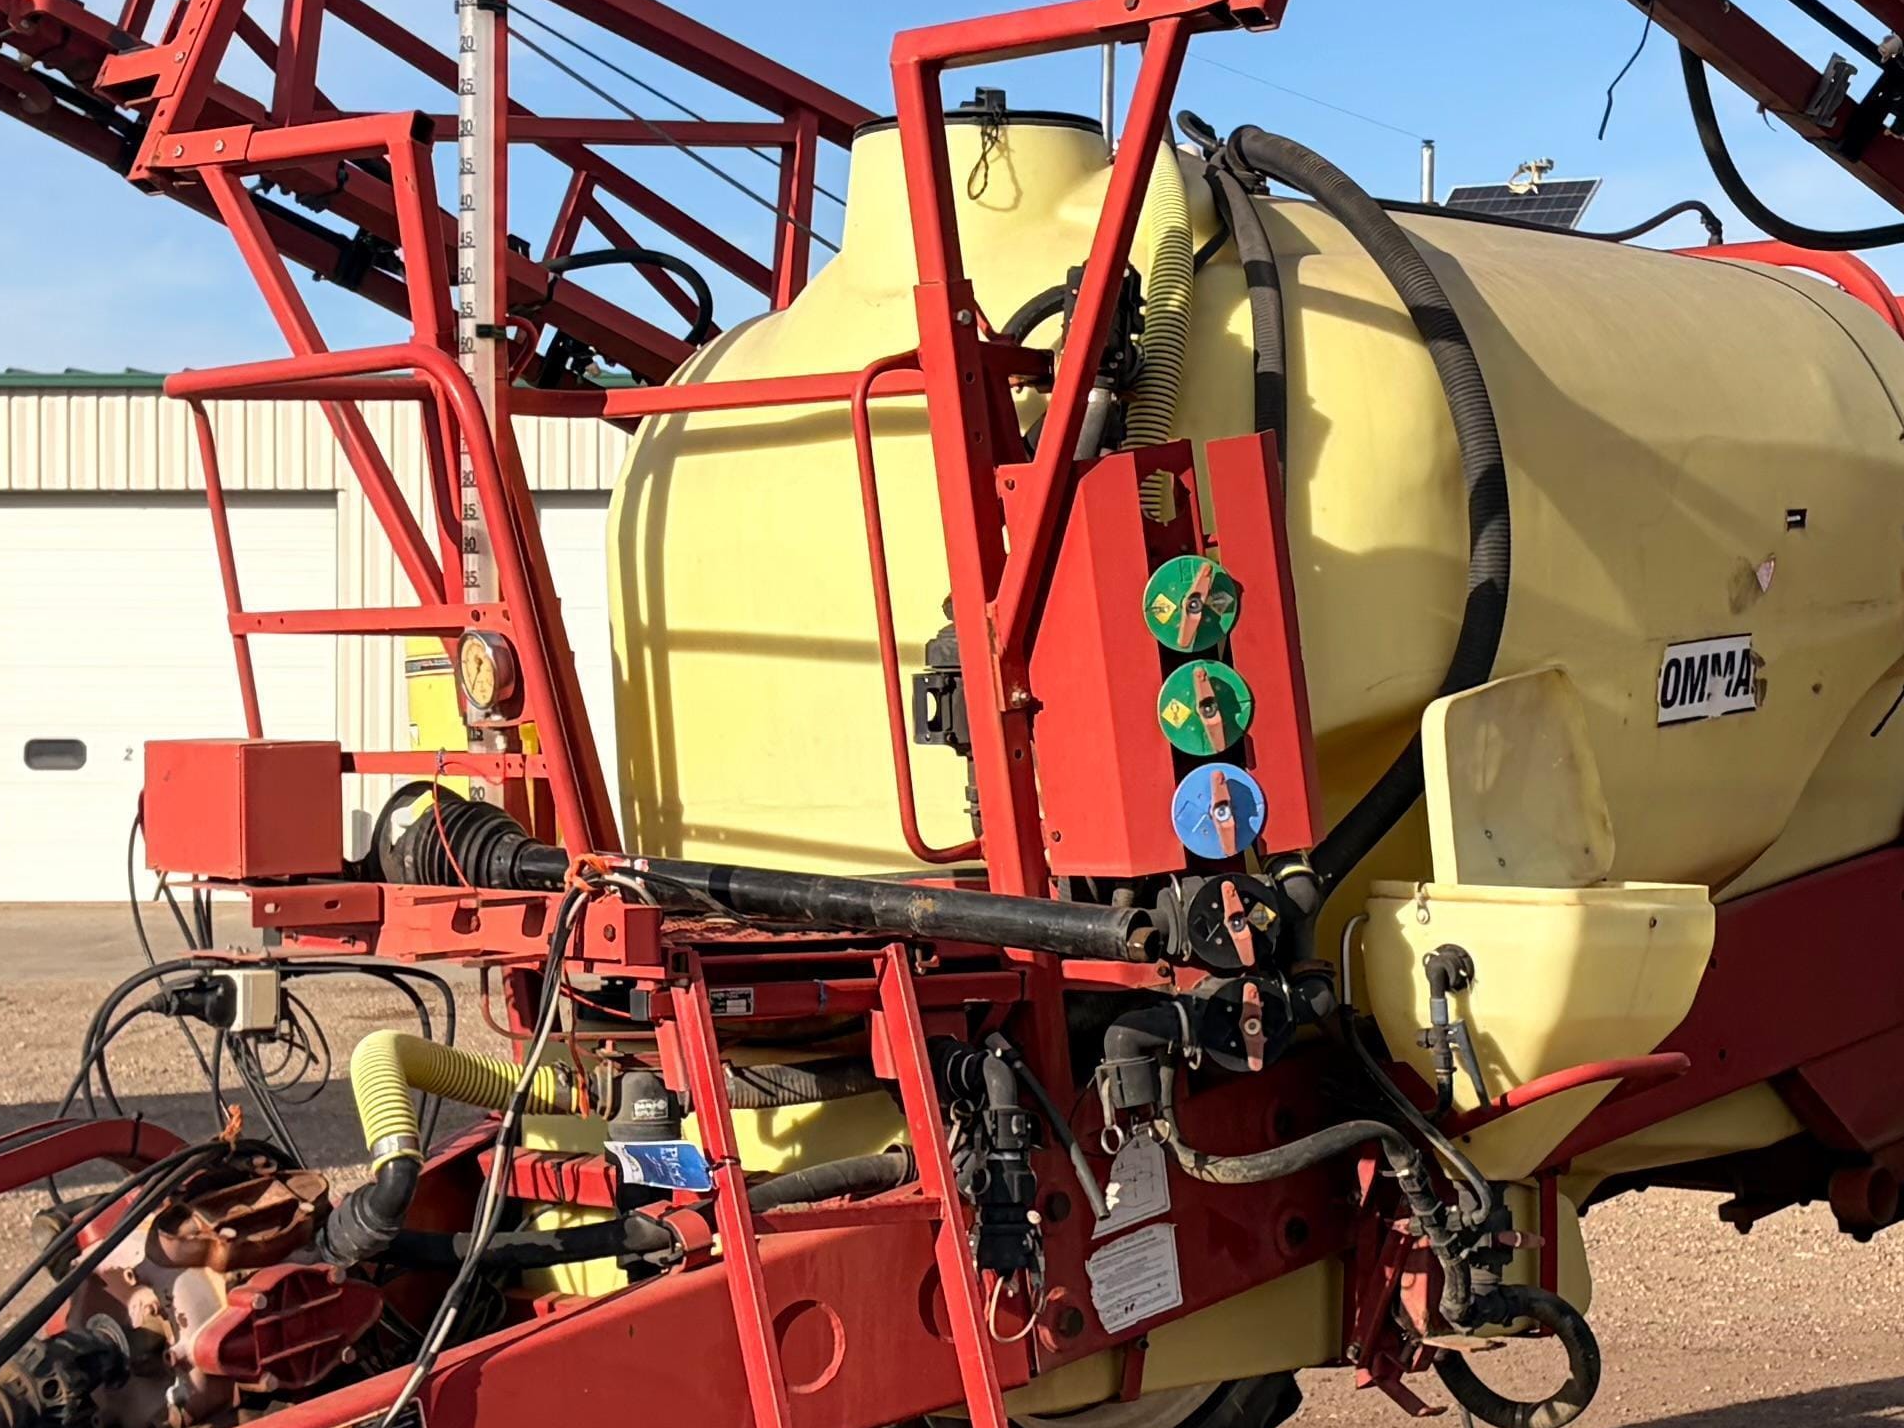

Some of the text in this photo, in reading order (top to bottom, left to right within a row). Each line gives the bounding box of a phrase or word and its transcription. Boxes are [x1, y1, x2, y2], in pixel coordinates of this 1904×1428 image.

[460, 35, 474, 51] 20
[460, 78, 474, 92] 25
[1658, 648, 1756, 709] OMMA
[123, 747, 134, 762] 2
